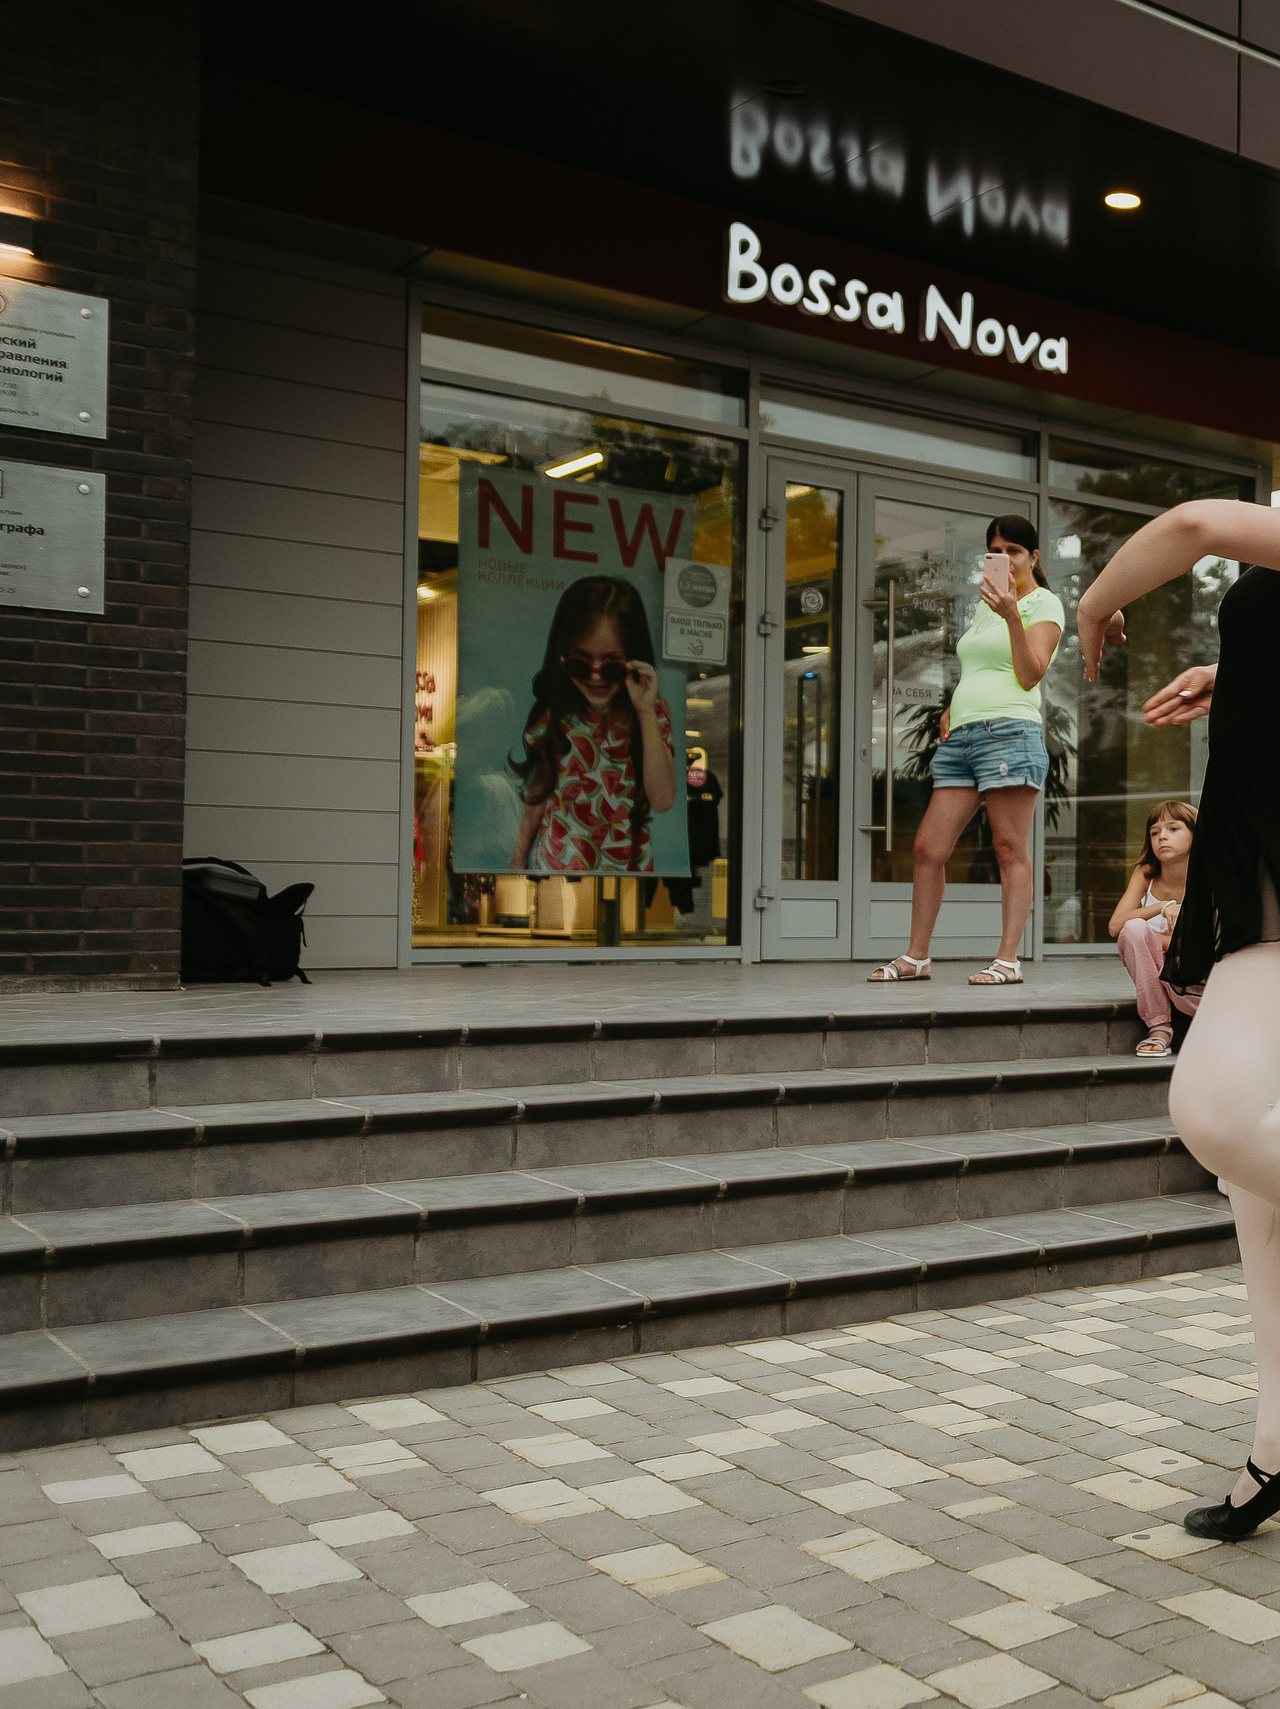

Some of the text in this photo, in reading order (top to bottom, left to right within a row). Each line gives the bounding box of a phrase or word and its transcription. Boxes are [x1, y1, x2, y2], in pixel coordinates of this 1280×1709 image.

[726, 221, 1069, 374] Bossa Nova
[477, 477, 685, 571] NEW
[478, 558, 526, 574] НОВЫЕ
[478, 570, 565, 592] КОЛЛЕКЦИИ
[670, 616, 722, 631] ВХОД ТОЛЬКО
[687, 629, 713, 639] МАСКЕ
[905, 687, 932, 698] СЕБЯ
